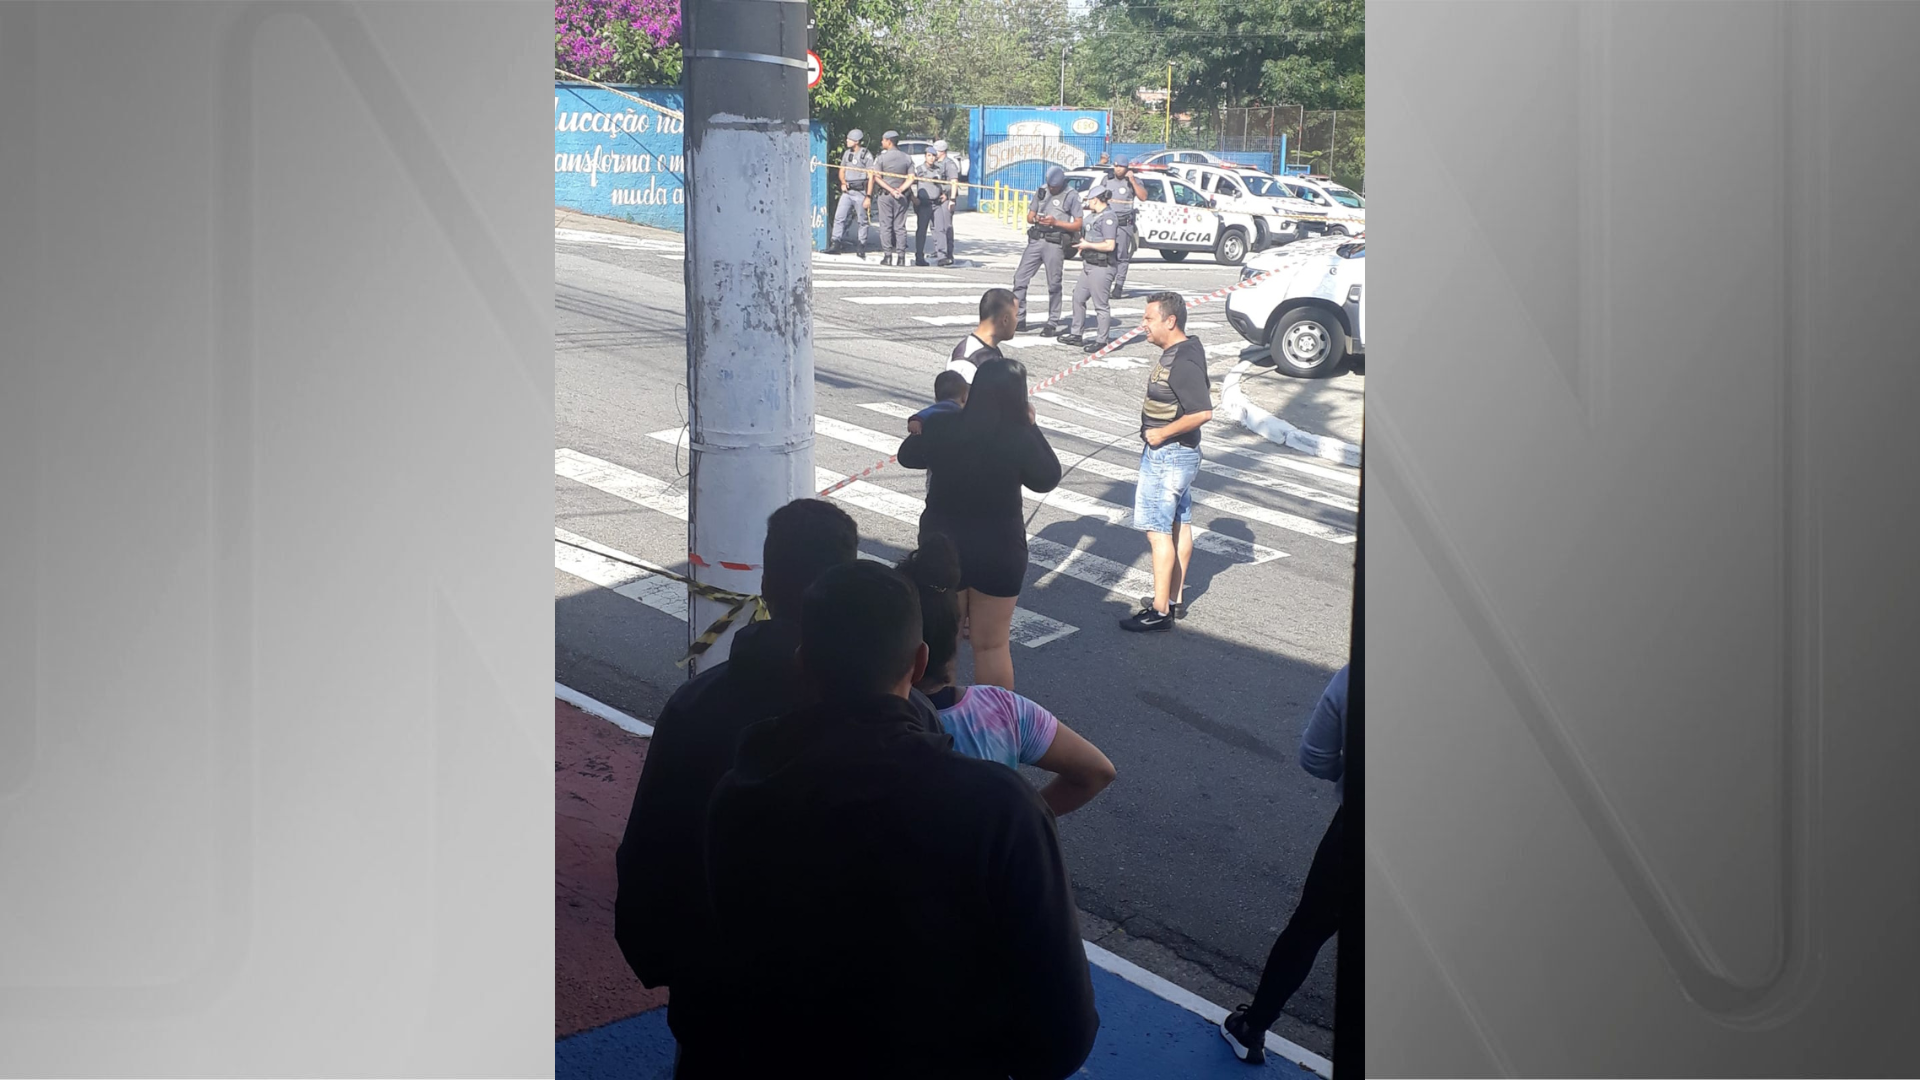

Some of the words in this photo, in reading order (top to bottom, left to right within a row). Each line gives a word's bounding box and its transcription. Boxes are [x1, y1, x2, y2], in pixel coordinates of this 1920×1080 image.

[657, 154, 667, 173] o
[611, 175, 668, 205] muda
[1147, 229, 1212, 242] POLÍCIA
